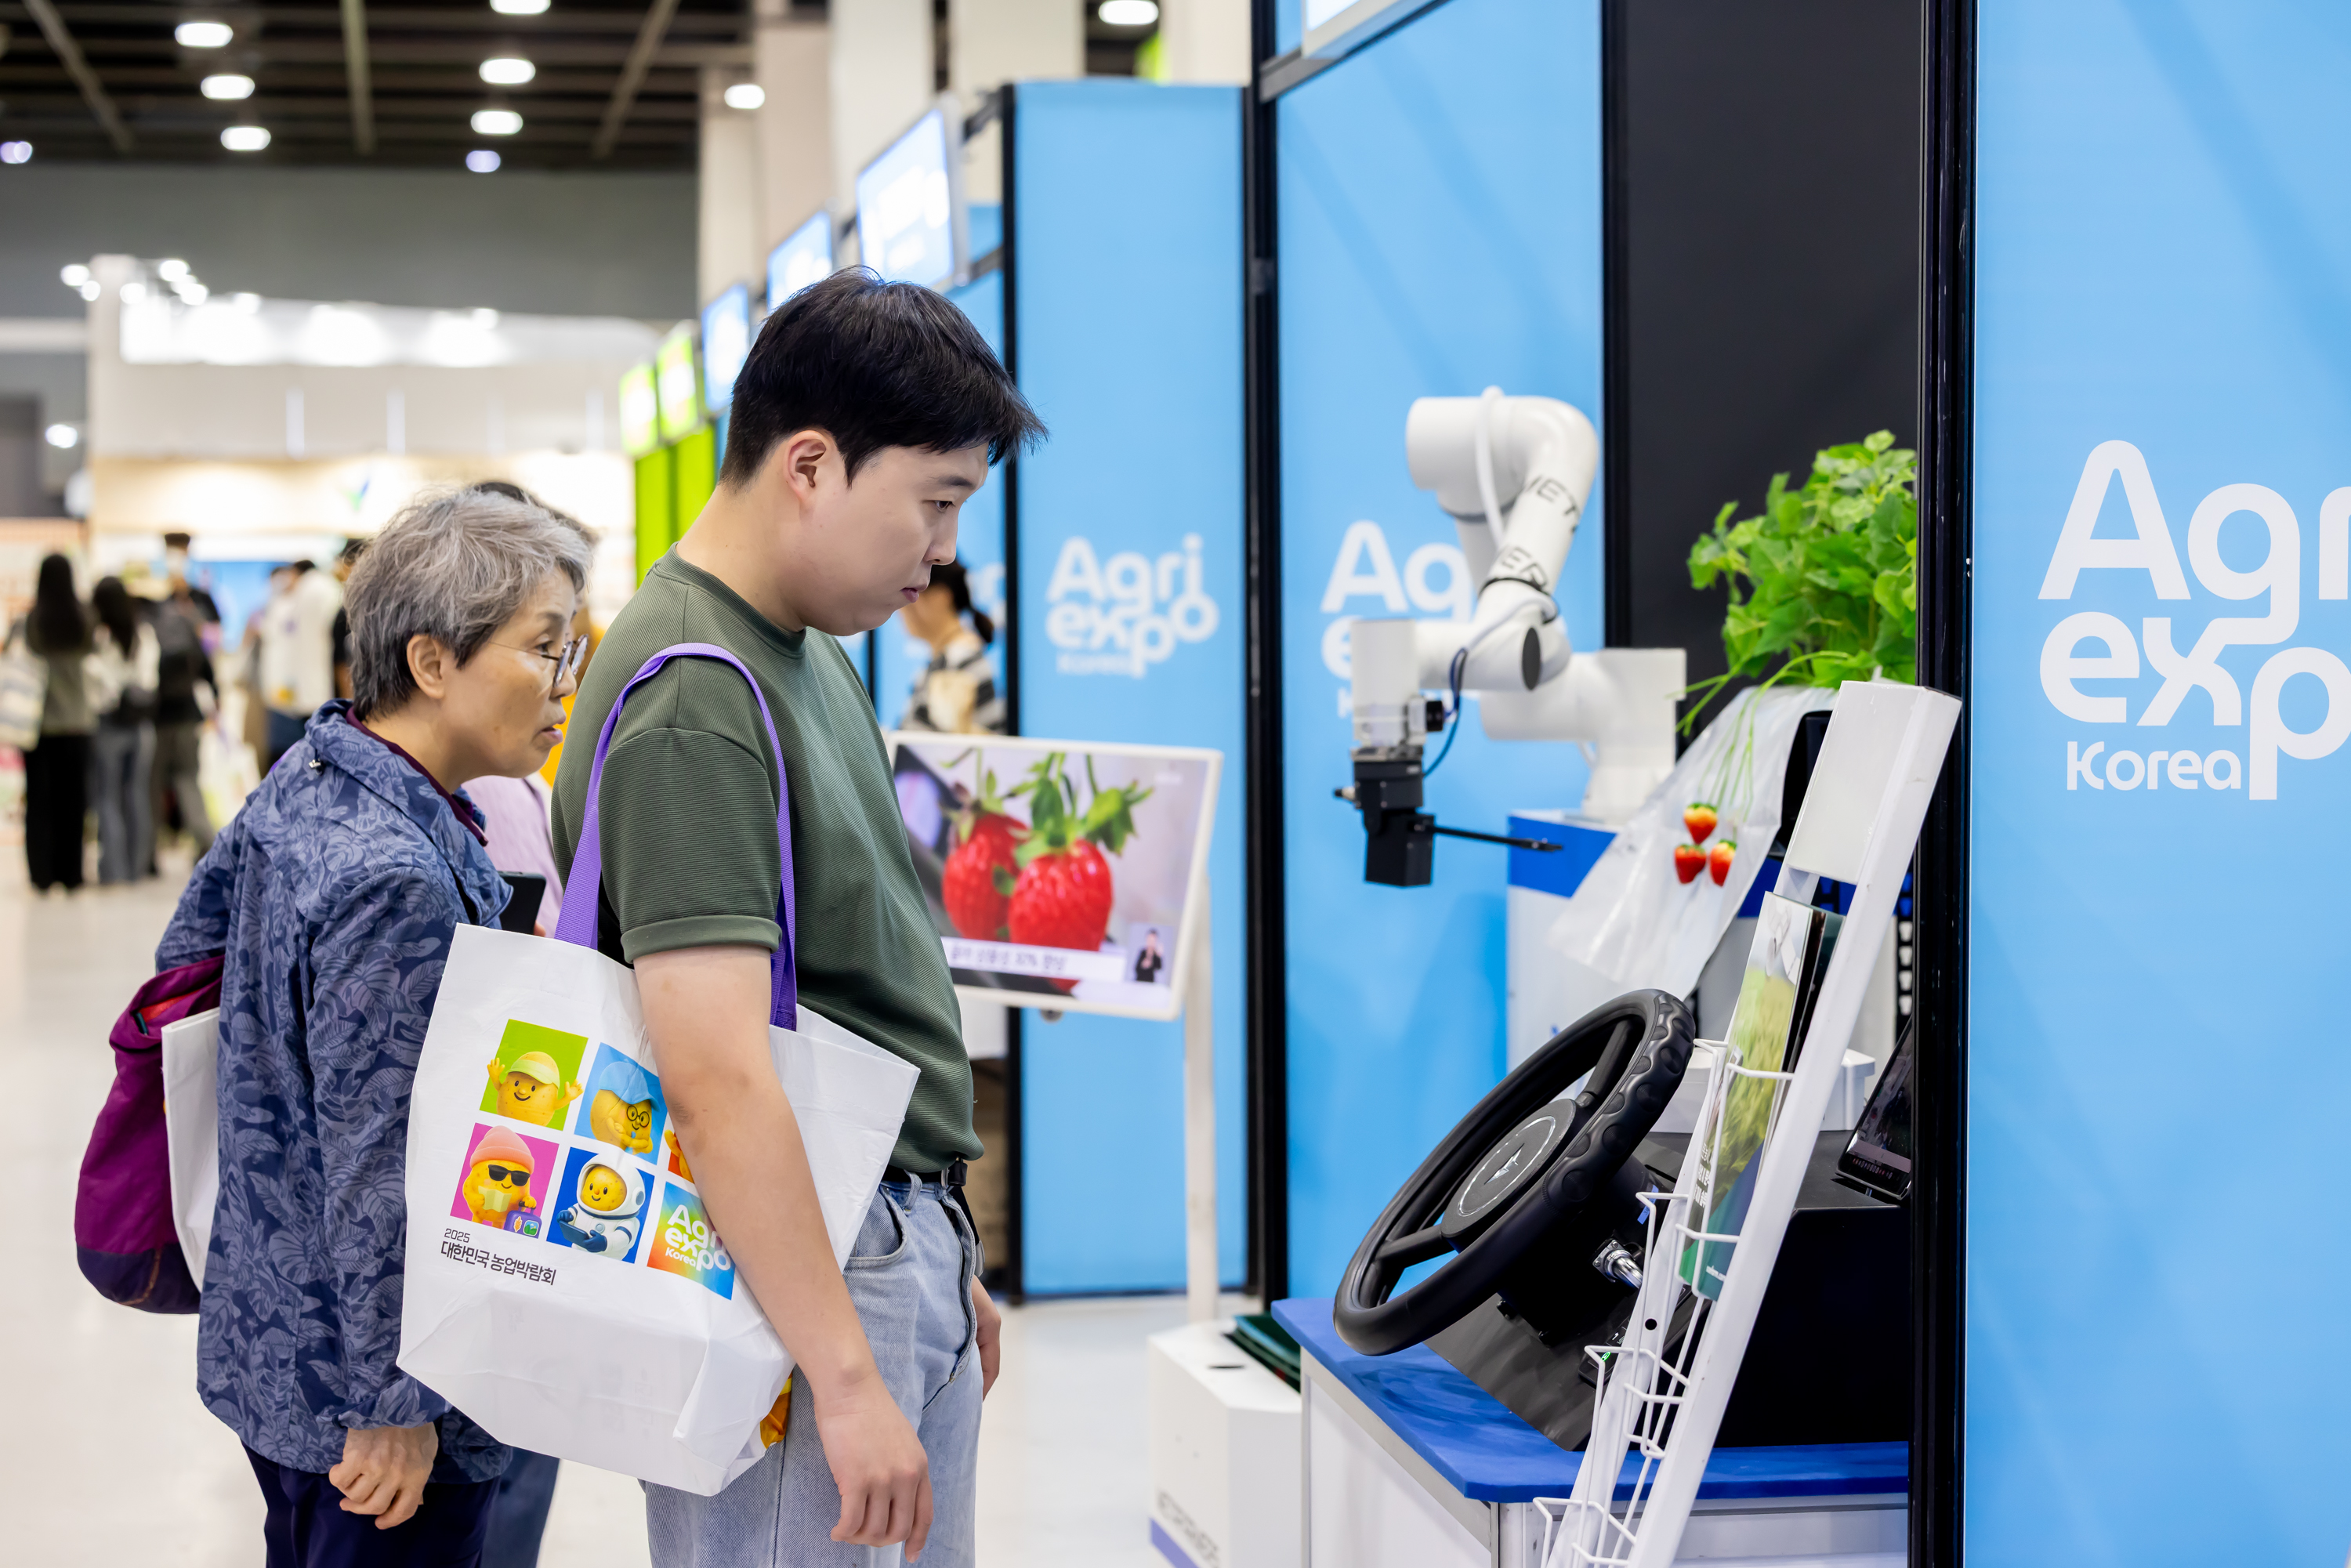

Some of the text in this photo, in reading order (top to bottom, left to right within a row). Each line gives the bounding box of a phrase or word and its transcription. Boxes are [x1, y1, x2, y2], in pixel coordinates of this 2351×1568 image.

[2038, 440, 2351, 644] Agr
[1045, 533, 1203, 611] Agri
[1320, 519, 1474, 625] Ag
[1045, 591, 1219, 679] expo
[2039, 611, 2351, 801] exp
[2067, 741, 2241, 791] Korea
[444, 1228, 471, 1243] 2025
[665, 1227, 731, 1272] expo
[667, 1204, 722, 1248] Agr
[440, 1240, 556, 1286] 대한민국 농업박람회
[665, 1247, 696, 1267] Korea
